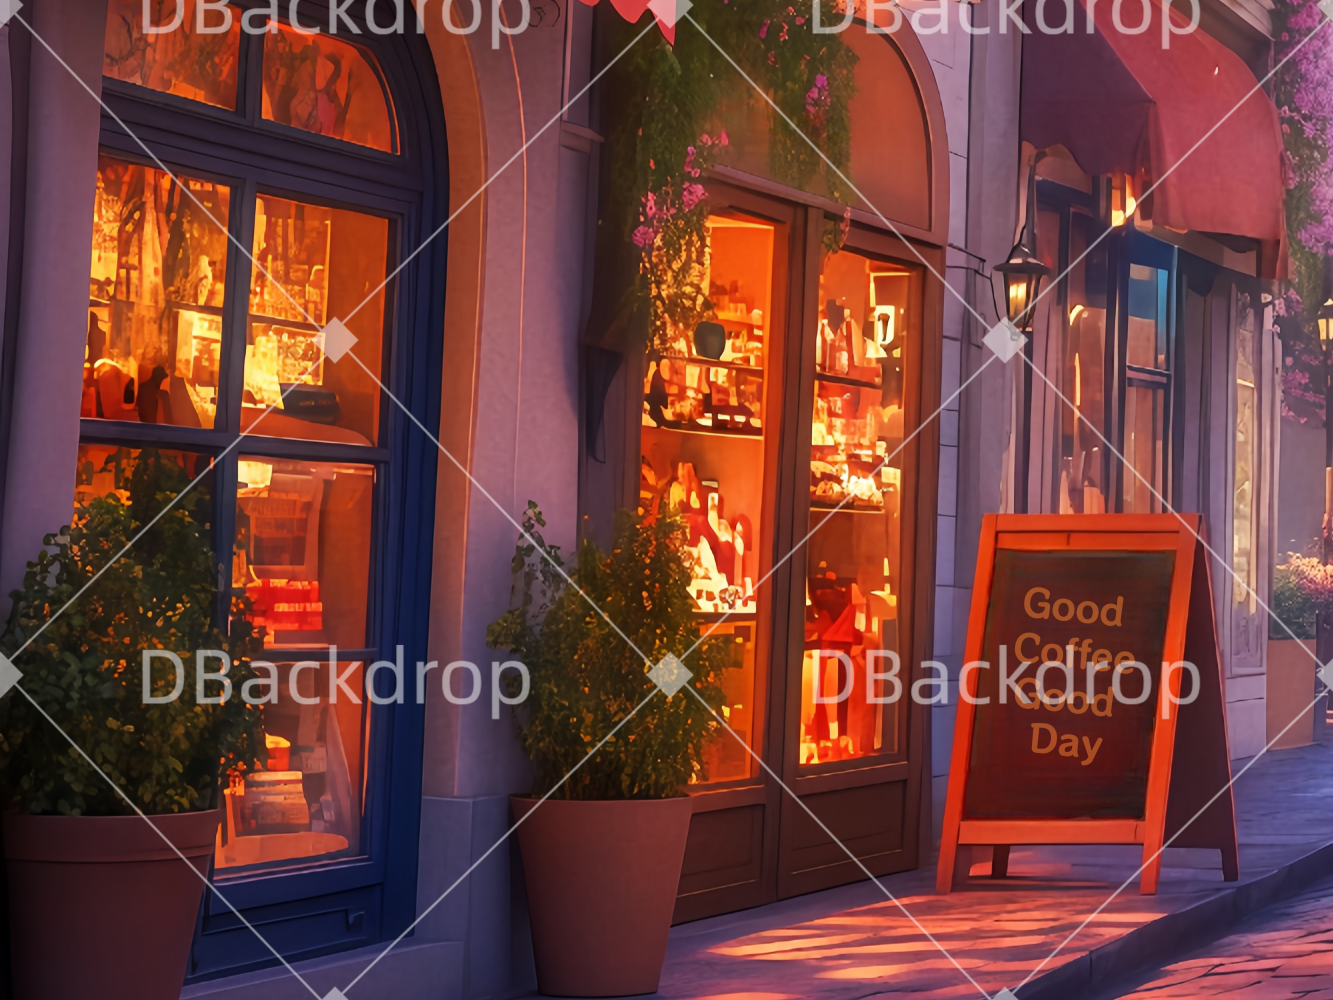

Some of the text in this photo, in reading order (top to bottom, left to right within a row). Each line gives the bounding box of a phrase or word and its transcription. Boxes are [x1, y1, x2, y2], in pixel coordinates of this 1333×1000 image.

[1024, 586, 1124, 627] Good
[1014, 632, 1136, 675] Coffee
[1014, 677, 1114, 718] Good
[1030, 722, 1103, 766] Day
